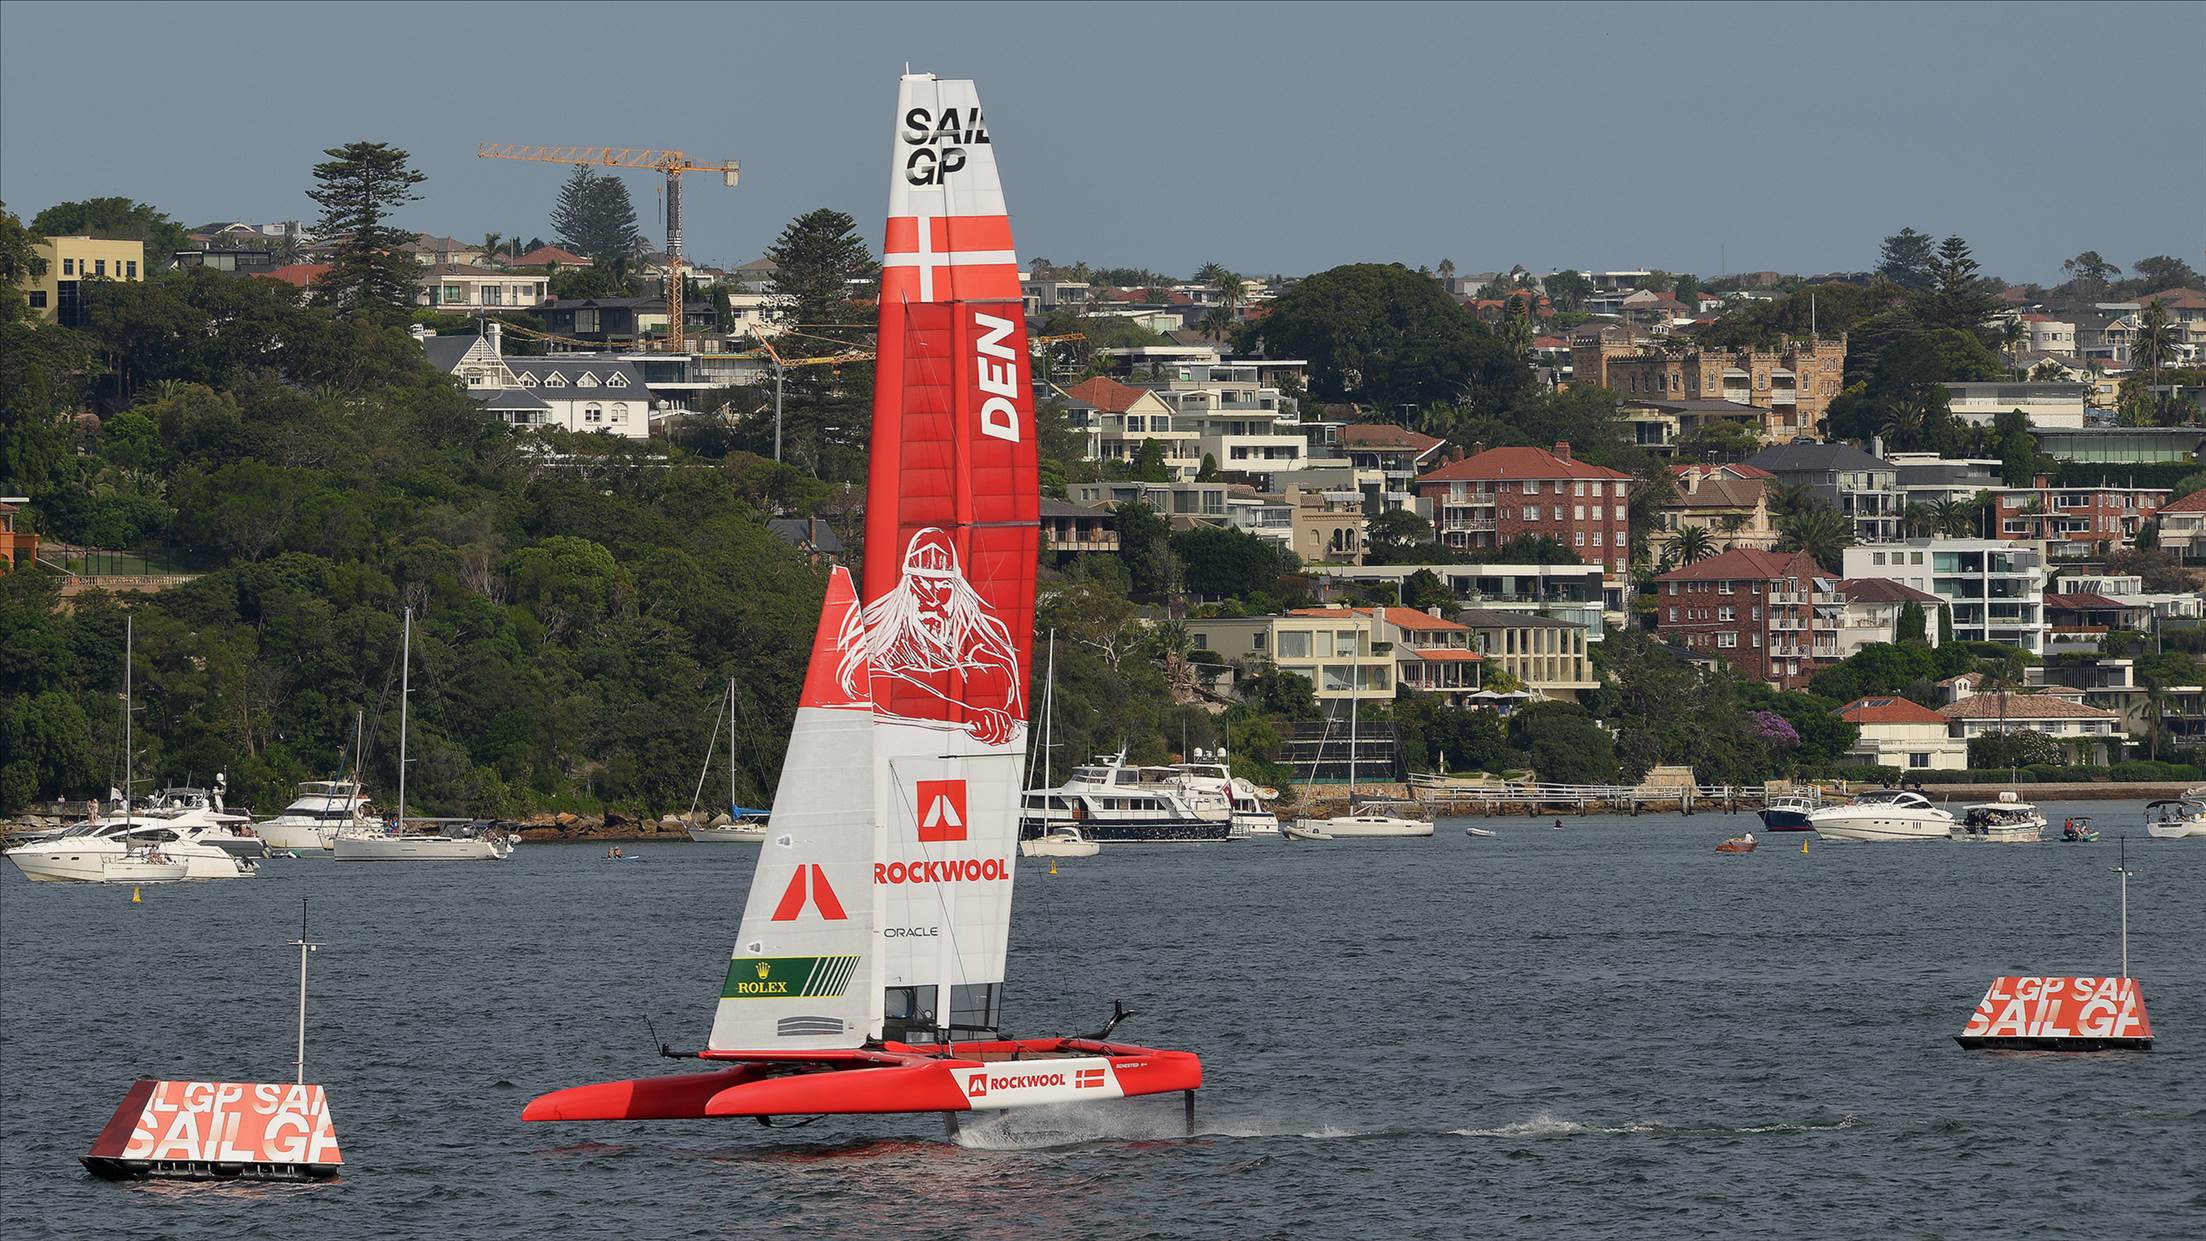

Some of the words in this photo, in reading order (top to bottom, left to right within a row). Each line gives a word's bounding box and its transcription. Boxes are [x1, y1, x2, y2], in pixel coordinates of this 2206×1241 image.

[902, 108, 991, 145] SAIL
[905, 148, 967, 186] GP
[975, 312, 1020, 442] DEN
[874, 859, 1009, 885] ROCKWOOL
[884, 927, 938, 938] ORACLE
[738, 982, 788, 993] ROLEX
[2015, 977, 2064, 1001] GP
[2072, 978, 2132, 1001] SAI
[1962, 1000, 2071, 1036] SAIL
[990, 1073, 1066, 1090] ROCKWOOL
[183, 1082, 242, 1113] GP
[252, 1084, 328, 1115] SAI
[121, 1111, 255, 1161] SAIL
